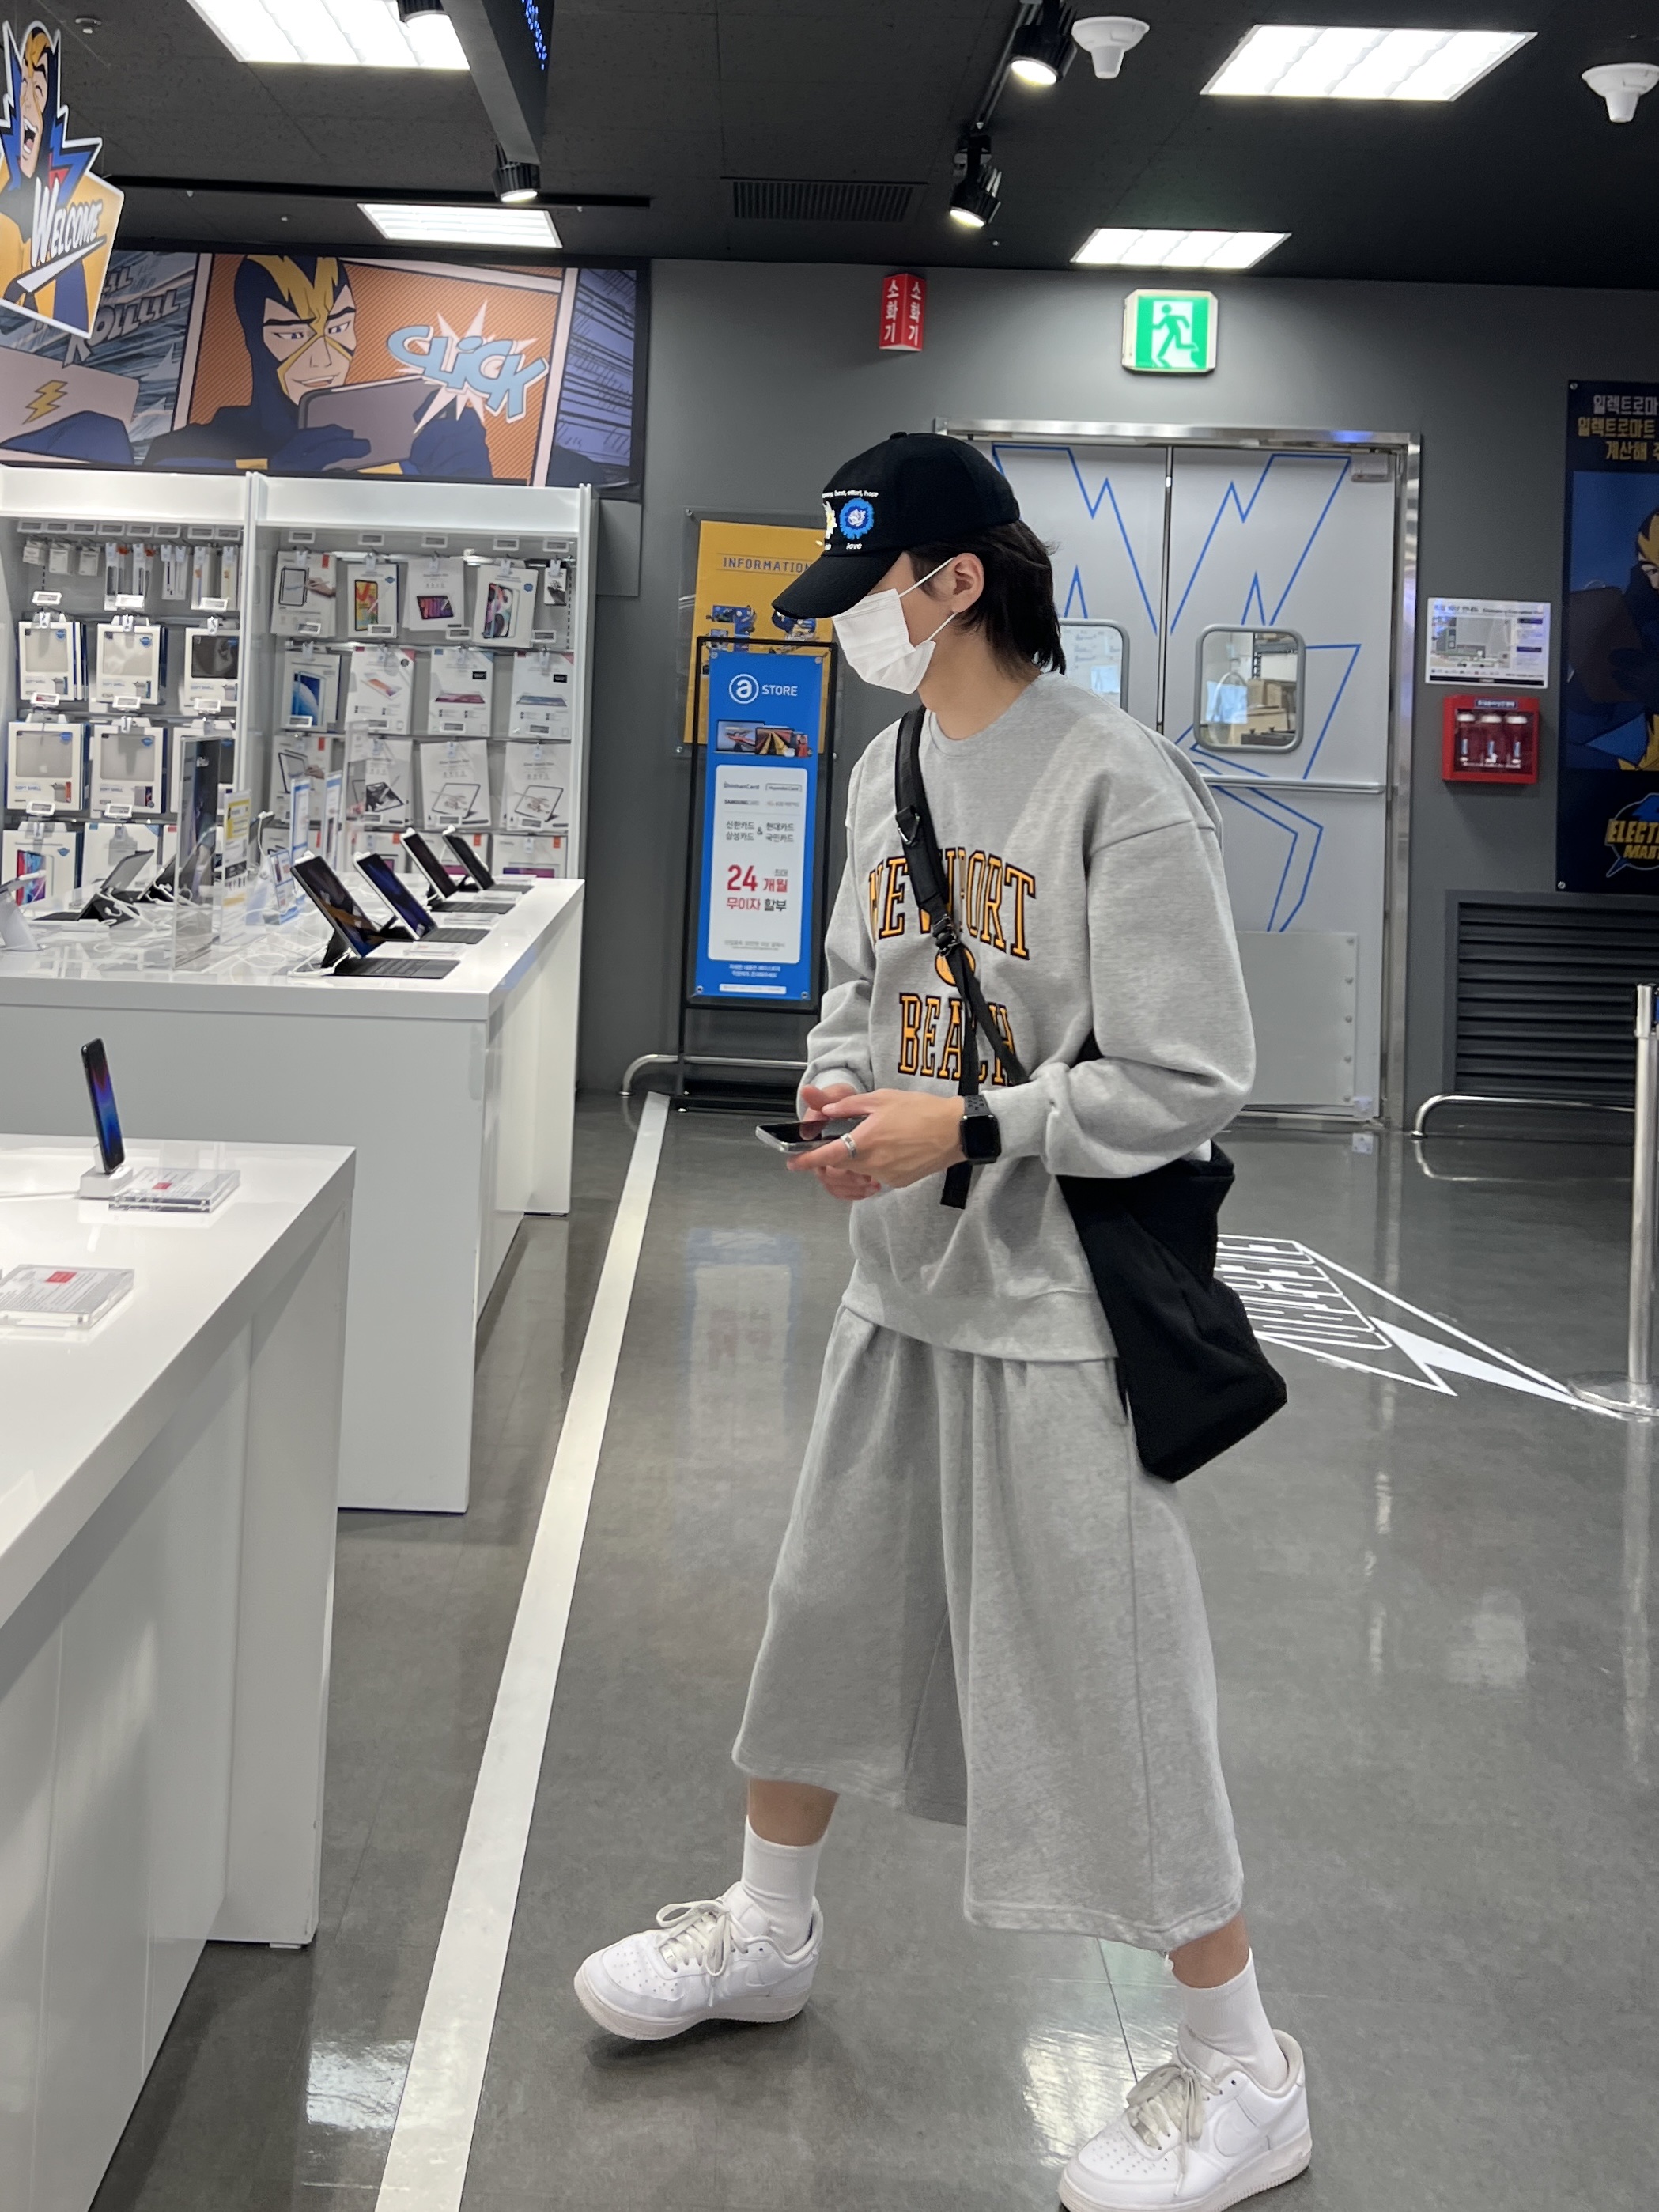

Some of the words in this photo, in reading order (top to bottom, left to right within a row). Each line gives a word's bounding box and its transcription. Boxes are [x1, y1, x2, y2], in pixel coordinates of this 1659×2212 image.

[31, 177, 104, 267] WELCOME
[884, 279, 899, 342] 소화기
[909, 281, 921, 346] 소화기
[1578, 417, 1655, 438] 일렉트로마트
[1605, 441, 1647, 461] 계산해
[761, 684, 798, 697] STORE
[726, 821, 754, 830] 신한카드
[766, 822, 794, 832] 현대카드
[726, 831, 754, 841] 삼성카드
[765, 833, 794, 842] 국민카드
[1607, 820, 1659, 844] ELECT
[1623, 845, 1659, 860] MAR
[727, 864, 758, 891] 24
[763, 878, 788, 892] 개월
[727, 897, 761, 910] 무이자
[764, 898, 787, 912] 할부
[898, 992, 1018, 1086] BEAH
